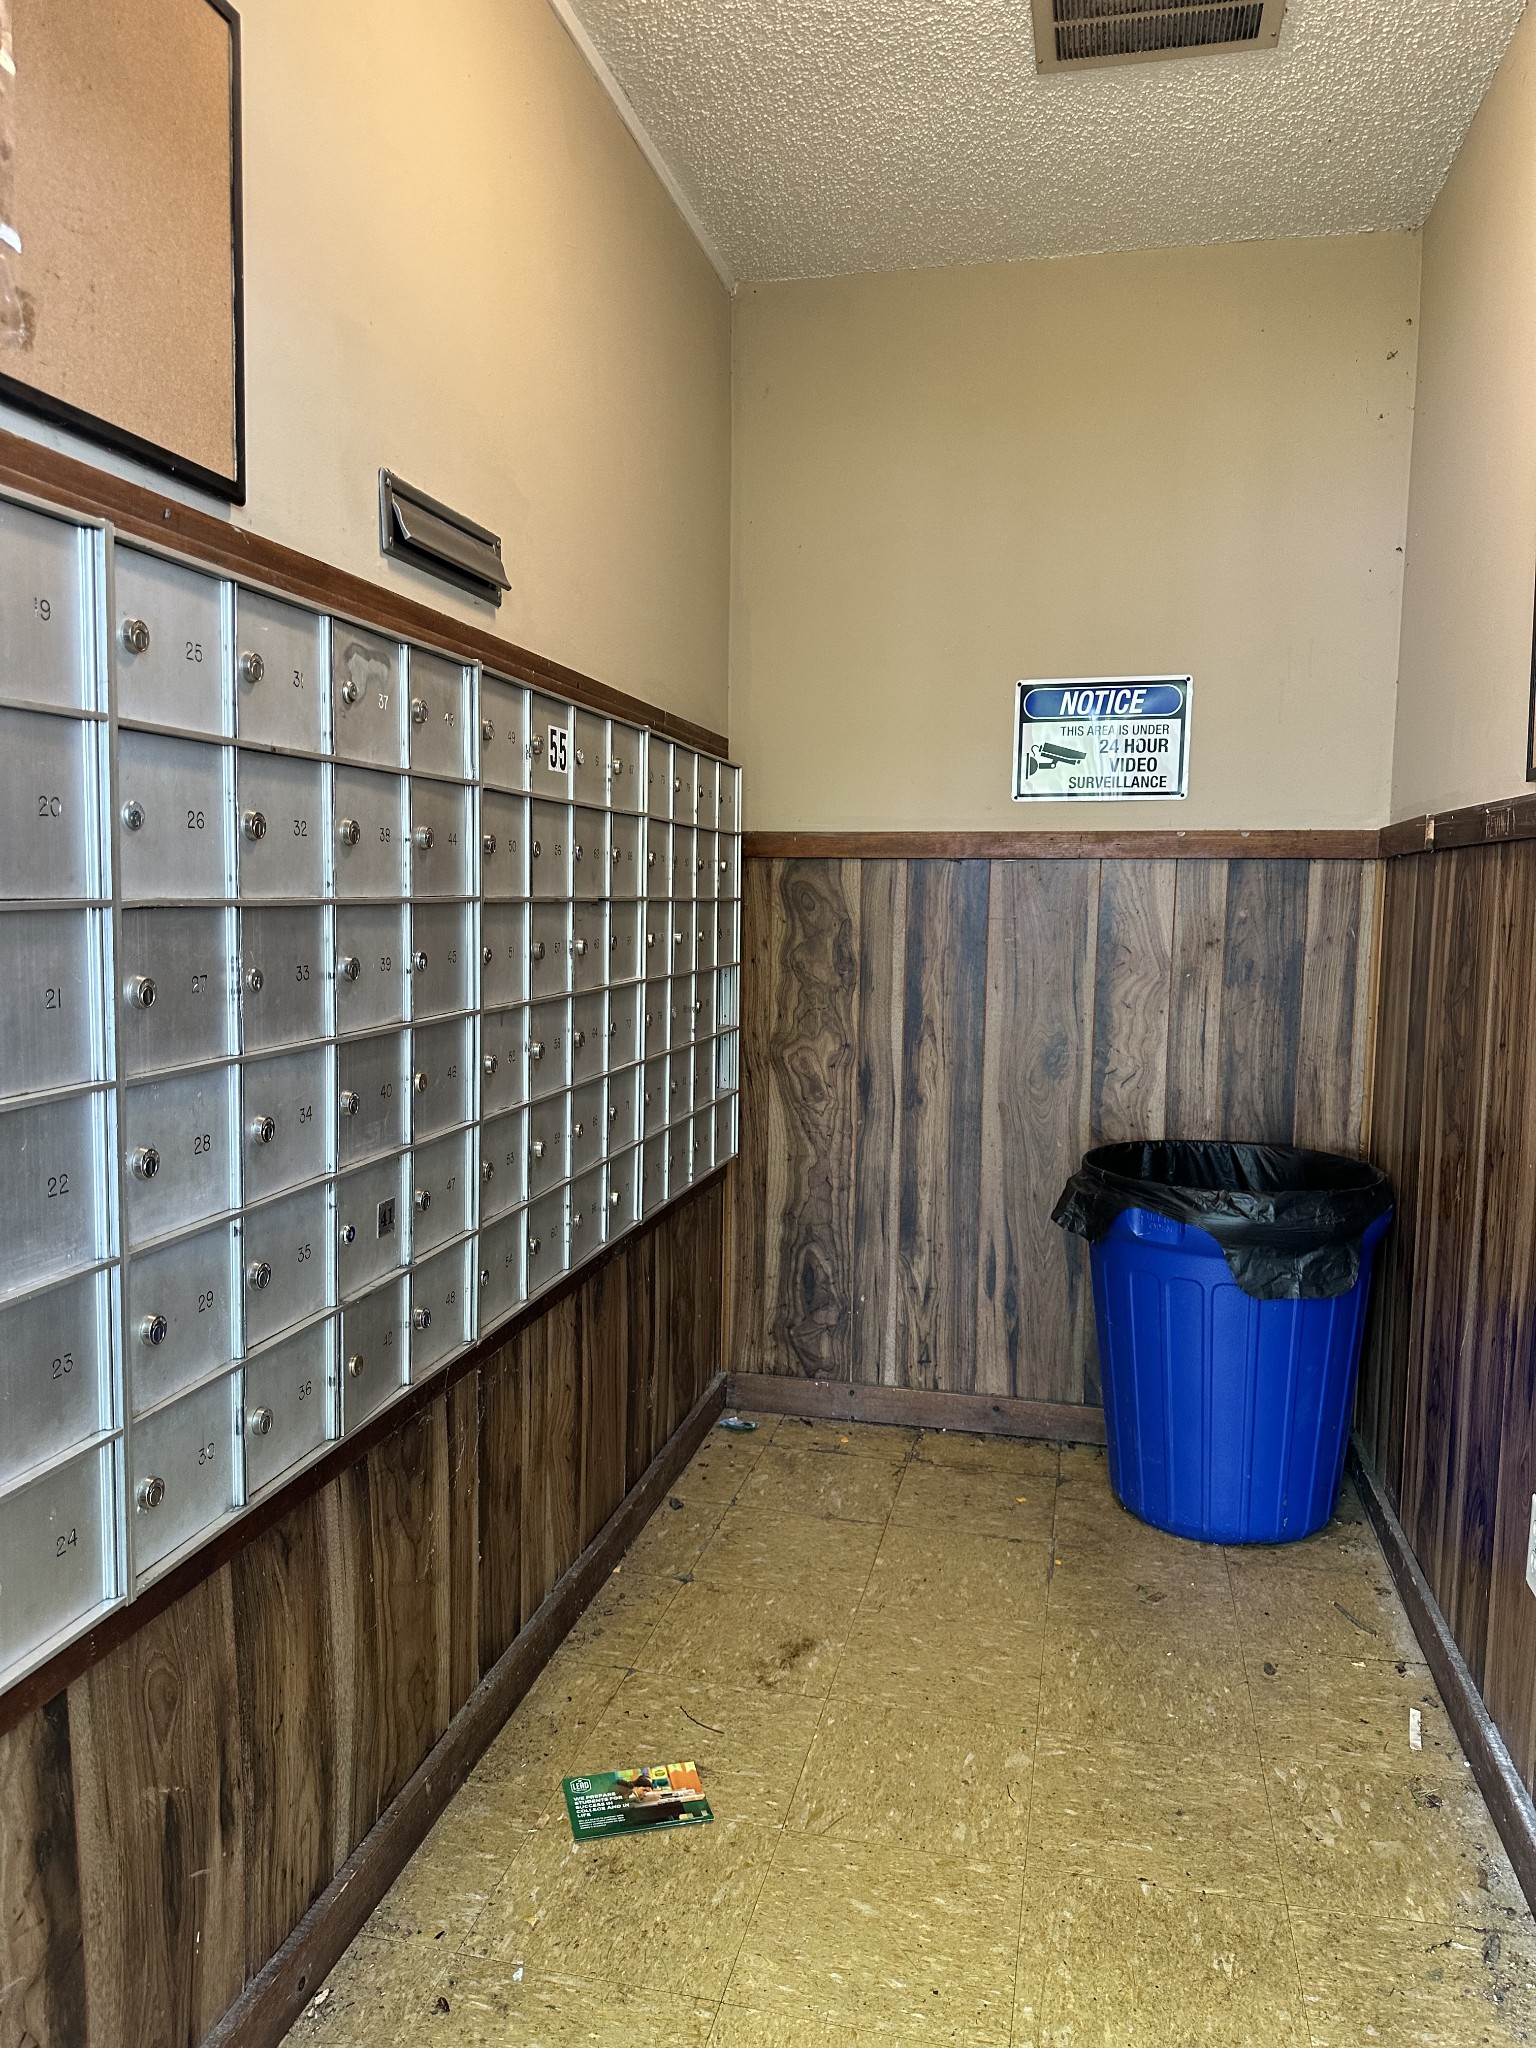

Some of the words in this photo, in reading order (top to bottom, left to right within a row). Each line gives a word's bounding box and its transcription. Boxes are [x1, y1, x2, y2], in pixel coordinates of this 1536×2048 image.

[186, 641, 203, 662] 25
[293, 670, 304, 689] 31
[378, 693, 389, 711] 37
[1059, 689, 1146, 715] NOTICE
[1060, 726, 1084, 736] THIS
[1087, 725, 1114, 736] AREA
[1118, 725, 1129, 735] IS
[1132, 724, 1170, 734] UNDER
[550, 728, 567, 770] 55
[1100, 739, 1119, 753] 24
[1124, 738, 1169, 753] HOUR
[1110, 757, 1158, 772] VIDEO
[1068, 776, 1167, 789] SURVEILLANCE
[38, 796, 62, 817] 20
[187, 811, 205, 829] 26
[293, 820, 307, 837] 32
[379, 827, 391, 843] 38
[448, 833, 458, 847] 44
[295, 965, 310, 982] 33
[380, 957, 392, 972] 39
[191, 975, 208, 993] 27
[45, 988, 61, 1009] 21
[380, 1083, 393, 1099] 40
[299, 1105, 313, 1124] 34
[194, 1134, 211, 1155] 28
[47, 1173, 69, 1198] 22
[380, 1208, 394, 1227] 41
[297, 1243, 312, 1263] 35
[198, 1291, 214, 1313] 29
[52, 1353, 74, 1380] 23
[298, 1380, 312, 1401] 36
[198, 1442, 215, 1466] 30
[56, 1528, 78, 1557] 24
[572, 1782, 589, 1790] LEAD
